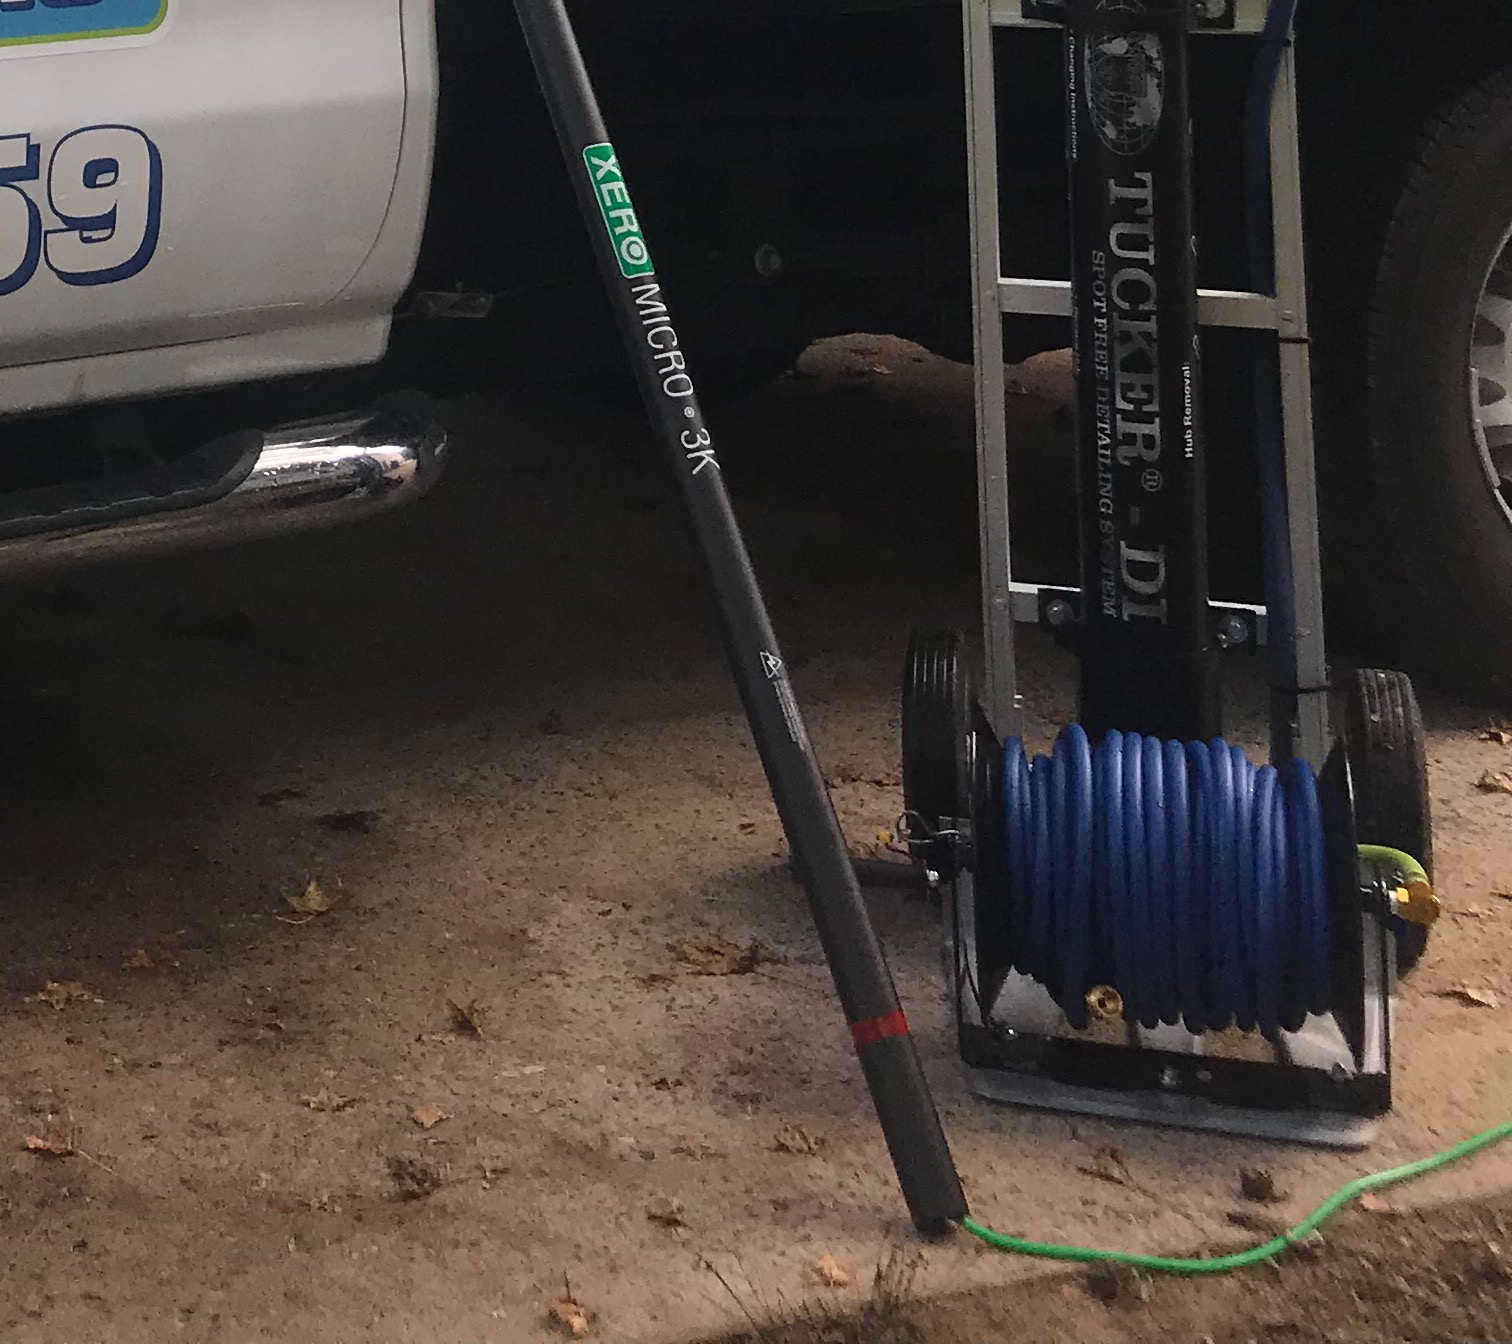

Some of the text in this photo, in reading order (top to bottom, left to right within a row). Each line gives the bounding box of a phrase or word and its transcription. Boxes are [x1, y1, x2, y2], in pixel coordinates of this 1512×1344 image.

[590, 153, 720, 475] XERO MICRO 3K
[1092, 250, 1108, 313] SPOT
[1093, 317, 1109, 380] FREE
[1096, 387, 1113, 515] DETAILING
[1182, 366, 1193, 459] Hub Removal
[1119, 539, 1168, 625] DI
